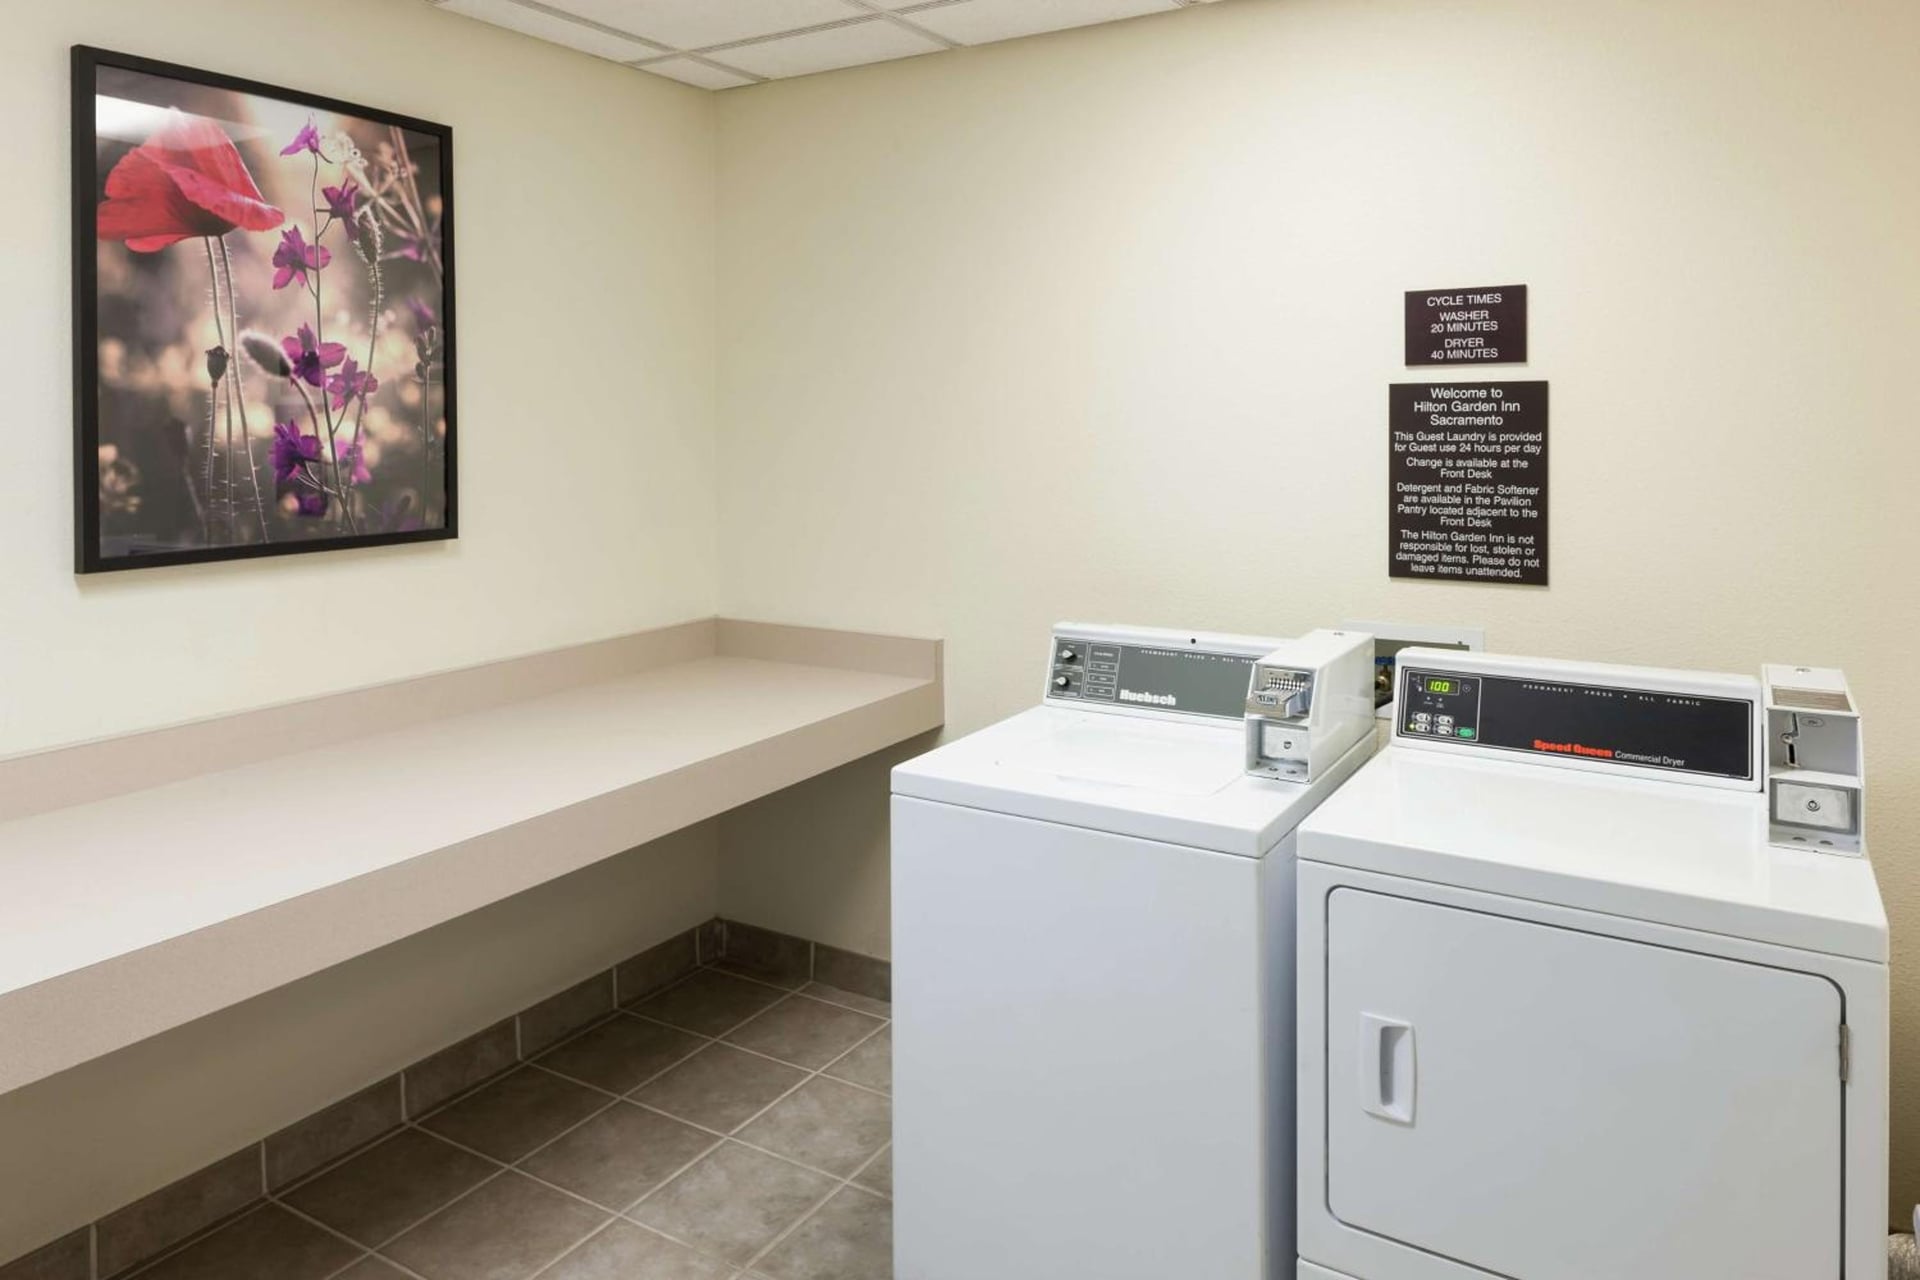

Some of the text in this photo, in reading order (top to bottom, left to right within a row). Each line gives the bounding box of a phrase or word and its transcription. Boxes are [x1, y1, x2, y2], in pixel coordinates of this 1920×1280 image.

[1427, 293, 1502, 307] CYCLE TIMES
[1440, 310, 1489, 321] WASHER
[1431, 321, 1498, 333] 20 MINUTES
[1445, 338, 1484, 348] DRYER
[1431, 348, 1498, 359] 40 MINUTES
[1430, 388, 1503, 399] Welcome to
[1414, 401, 1520, 412] Hilton Garden Inn
[1430, 414, 1503, 426] Sacramento
[1394, 431, 1542, 443] This Guest Laundry is provided
[1394, 443, 1541, 455] for Guest use 24 hours per day
[1406, 457, 1528, 469] Change is available at the
[1440, 468, 1492, 479] Front Desk
[1397, 482, 1539, 495] Detergent and Fabric Softener
[1421, 495, 1461, 504] available
[1464, 496, 1472, 504] in
[1475, 496, 1490, 505] the
[1494, 496, 1531, 506] Pavilion
[1397, 504, 1427, 516] Pantry
[1429, 506, 1463, 515] located
[1466, 507, 1507, 518] adjacent
[1522, 509, 1538, 518] the
[1440, 517, 1492, 527] Front Desk
[1401, 530, 1534, 544] The Hilton Garden Inn is not
[1400, 541, 1452, 552] responsible
[1455, 544, 1468, 552] for
[1470, 544, 1489, 554] lost,
[1493, 546, 1522, 554] stolen
[1396, 551, 1540, 567] damaged items. Please do not
[1411, 563, 1522, 578] leave items unattended.
[1119, 689, 1176, 706] Huebsch
[1533, 739, 1685, 767] Speed Queen Commercial Dryer
